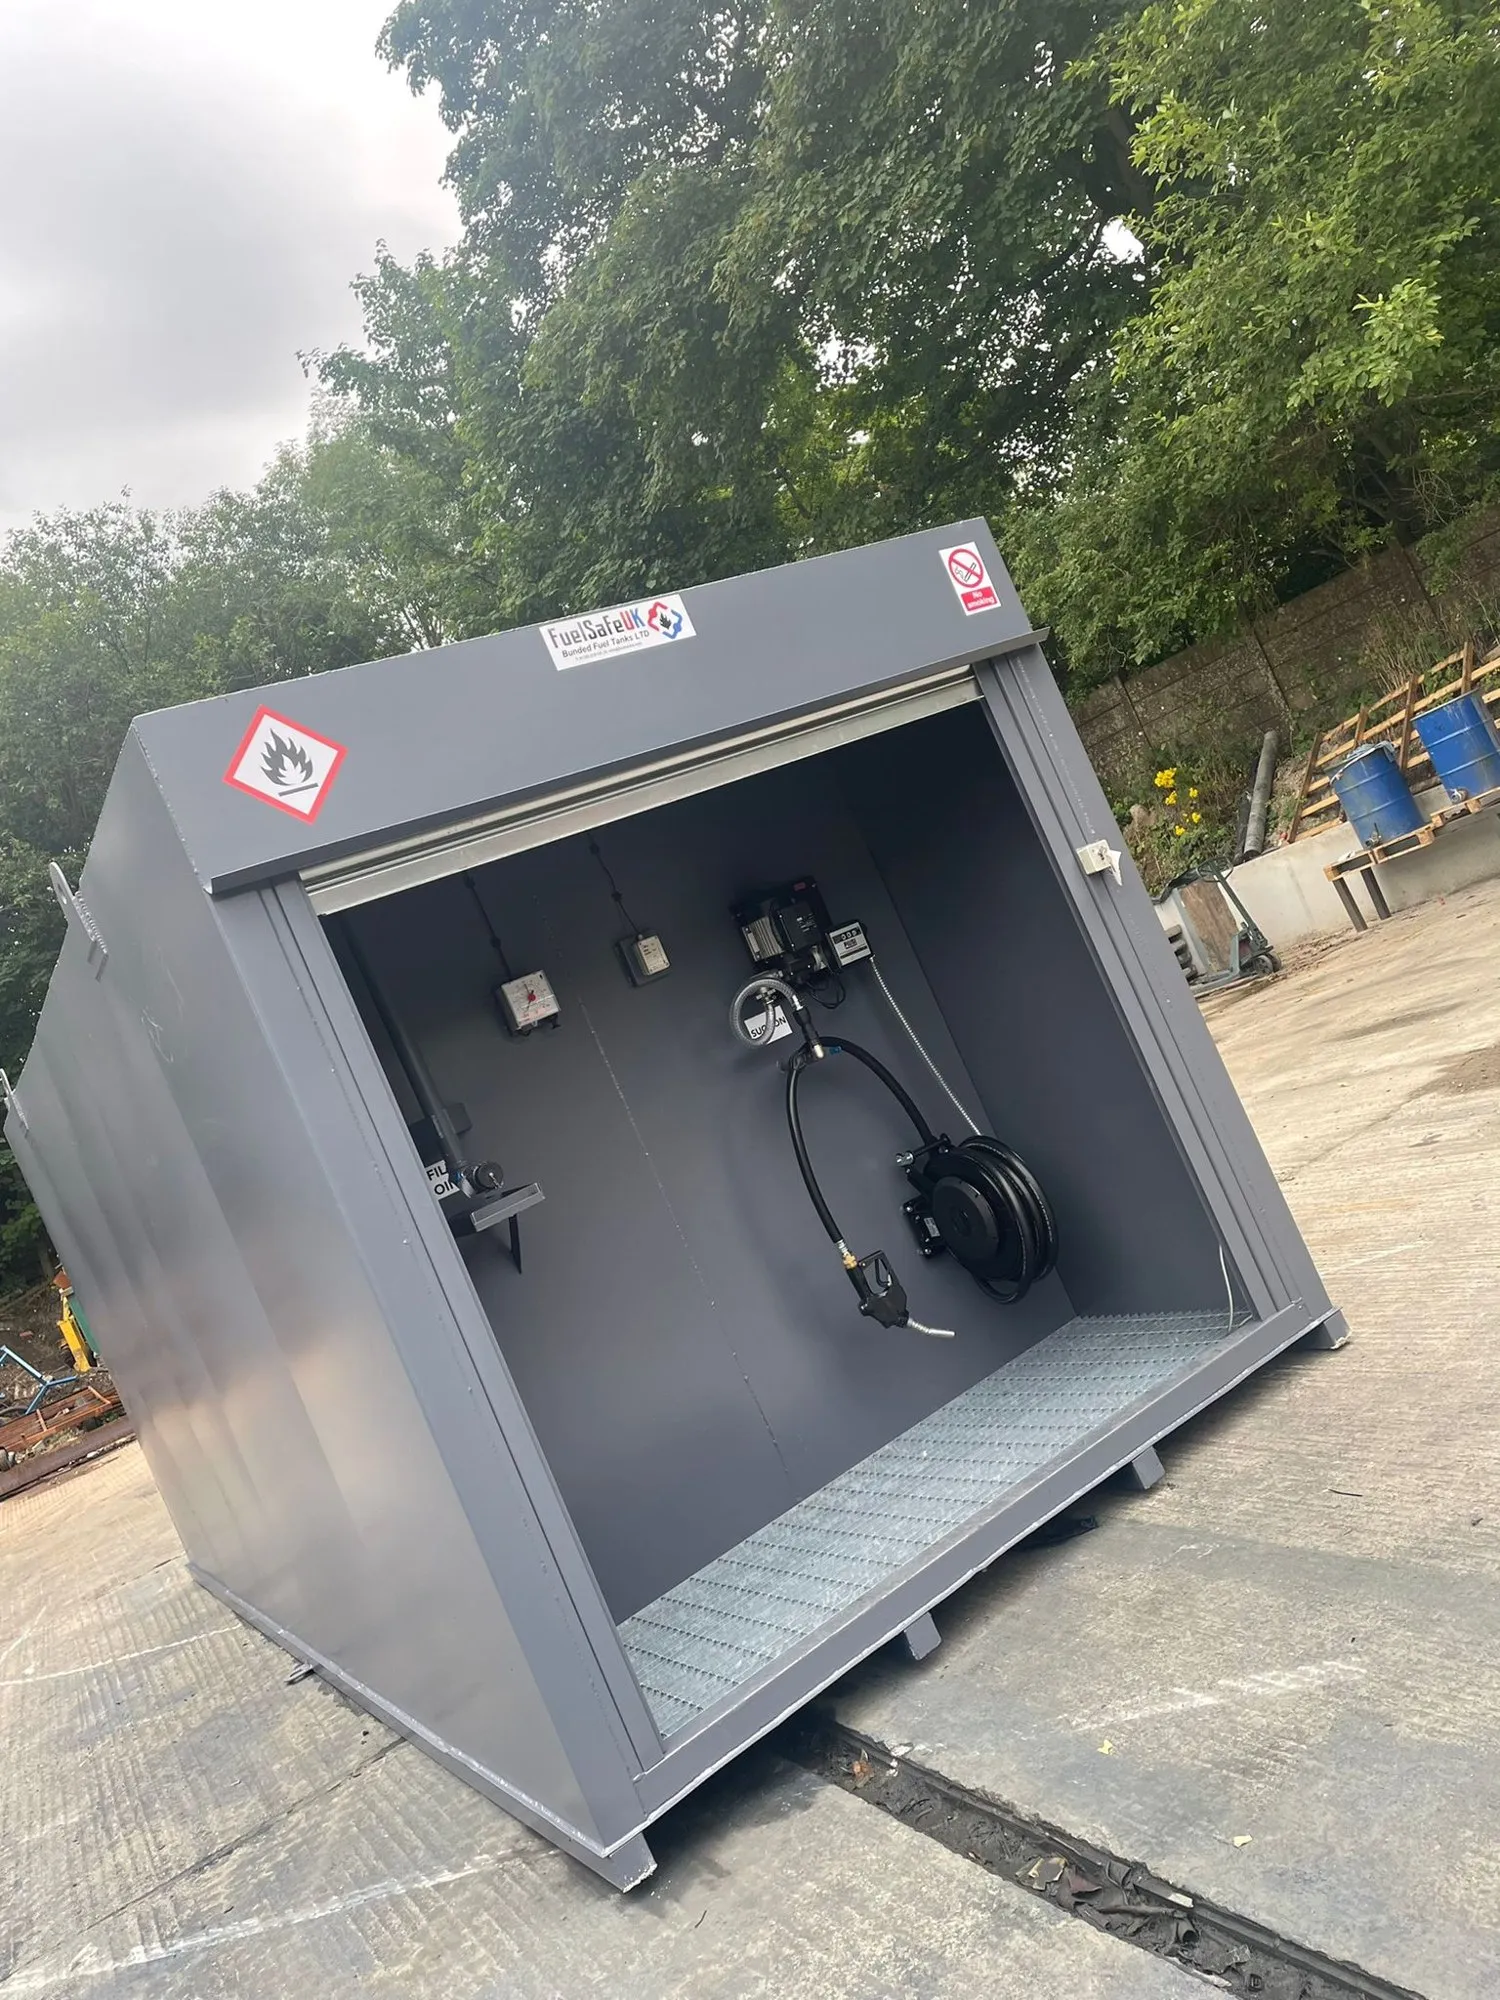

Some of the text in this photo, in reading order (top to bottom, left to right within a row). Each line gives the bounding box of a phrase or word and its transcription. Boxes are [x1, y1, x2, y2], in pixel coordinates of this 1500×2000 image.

[562, 644, 592, 658] Bunded
[593, 640, 610, 650] Fuel
[611, 634, 633, 646] Tanks
[634, 630, 650, 640] LTD
[751, 1016, 786, 1038] SUCON
[426, 1166, 448, 1181] FIL
